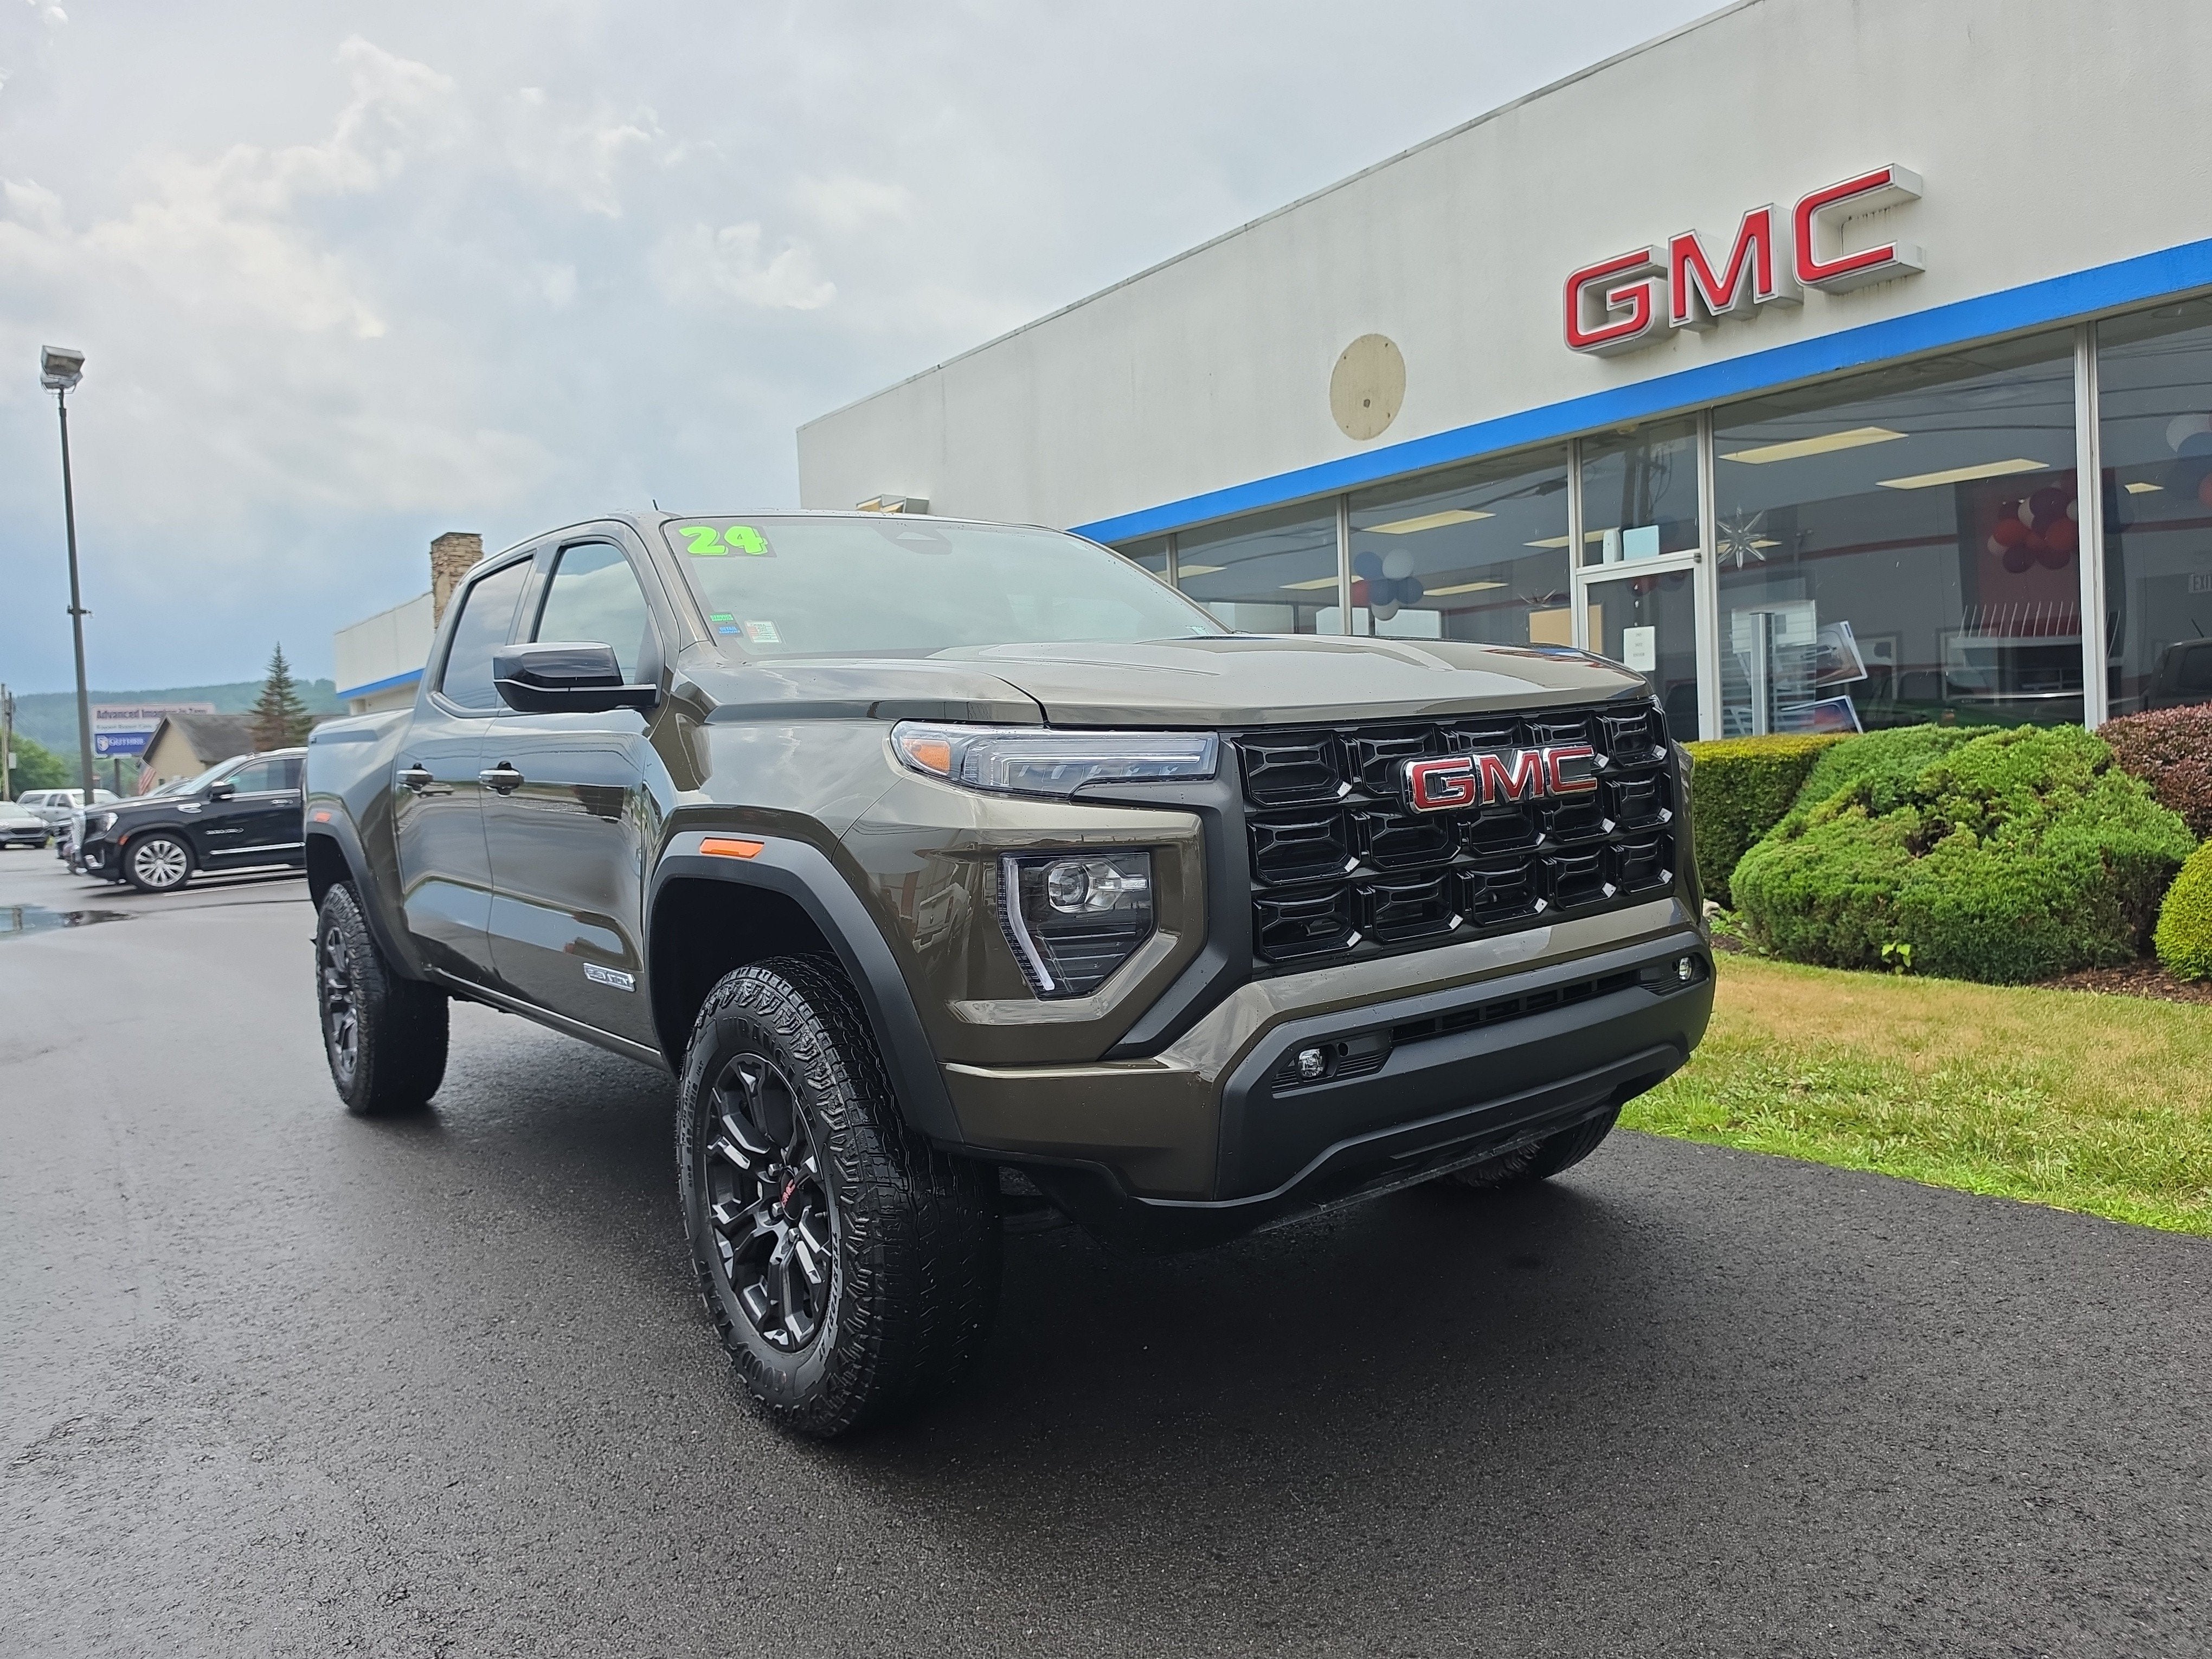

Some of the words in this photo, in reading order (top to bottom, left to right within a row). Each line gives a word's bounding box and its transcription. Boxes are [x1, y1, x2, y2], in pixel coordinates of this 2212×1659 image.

[1564, 163, 1914, 355] GMC
[679, 525, 768, 555] 24
[2193, 576, 2212, 591] EXI
[97, 709, 139, 719] Advanced
[1406, 744, 1598, 813] GMC
